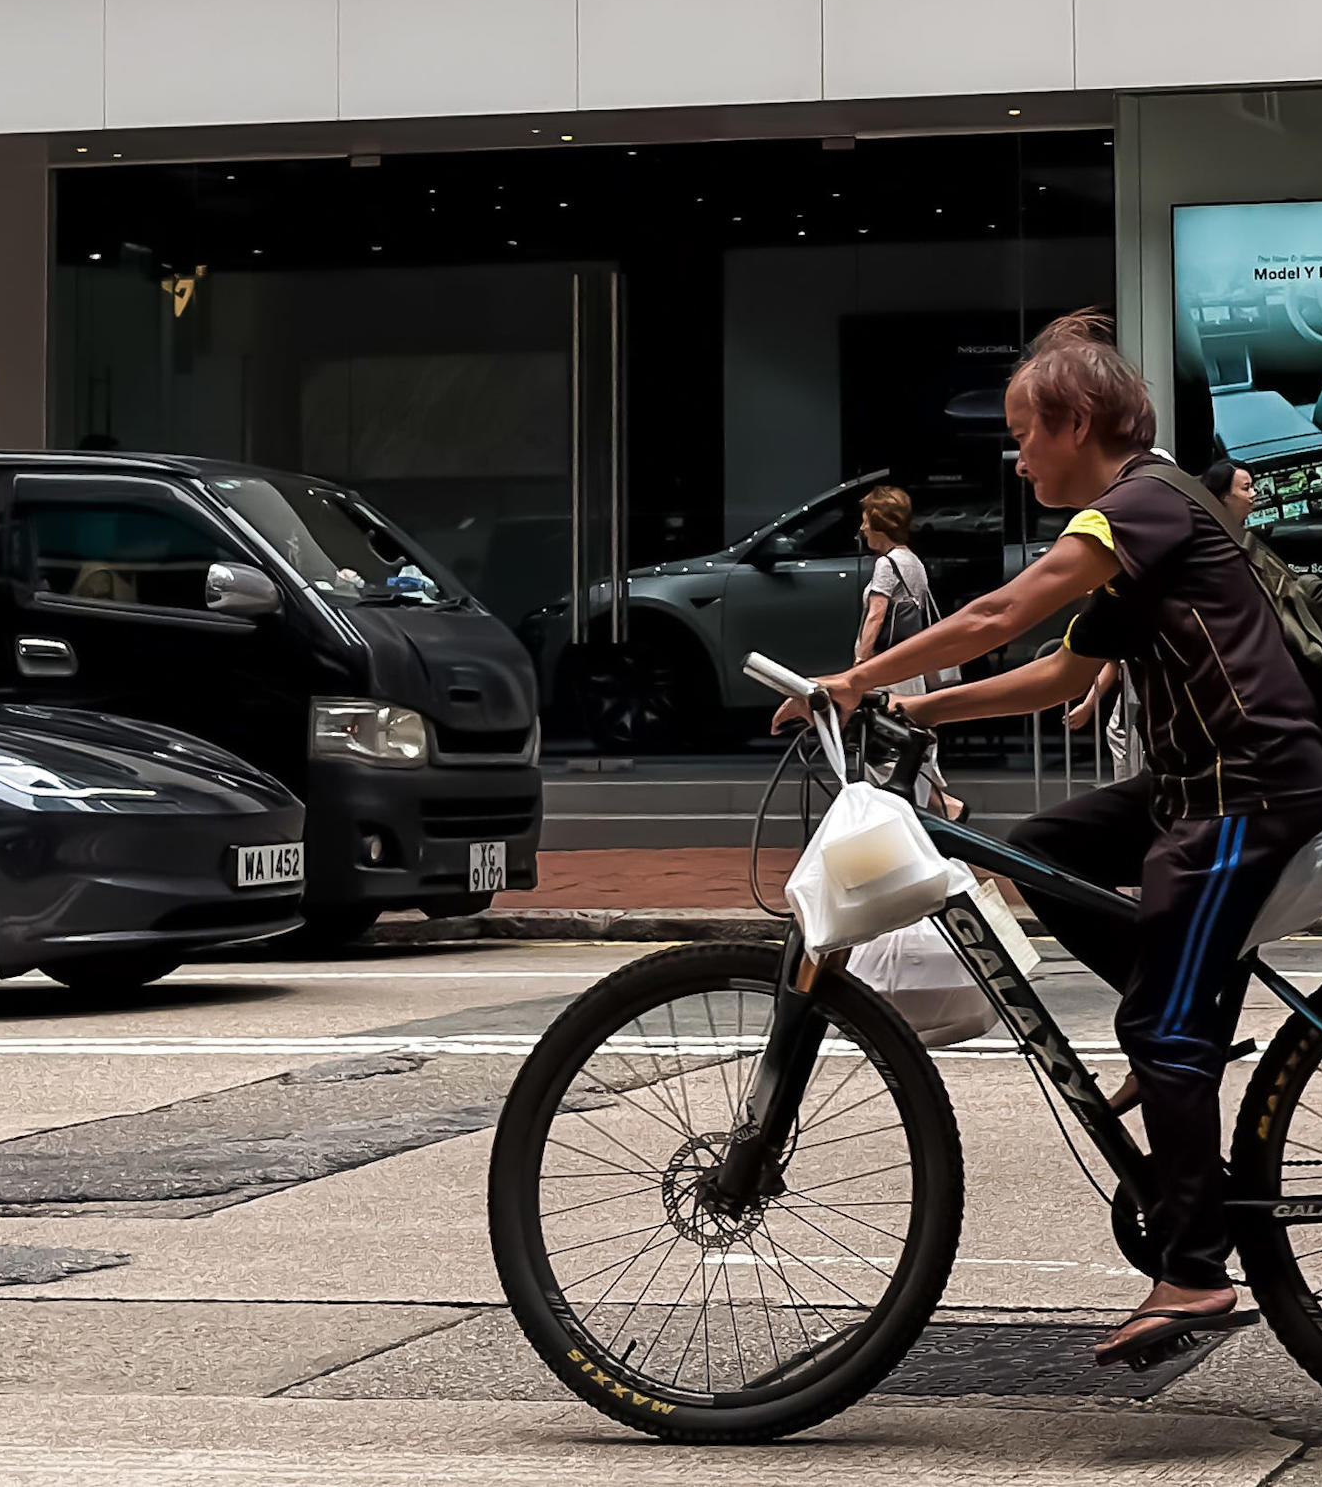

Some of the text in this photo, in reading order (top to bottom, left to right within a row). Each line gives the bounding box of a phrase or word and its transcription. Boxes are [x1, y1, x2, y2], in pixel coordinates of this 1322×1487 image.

[1254, 266, 1300, 280] Model
[1304, 265, 1315, 279] Y
[244, 848, 300, 881] WA 1452
[480, 843, 496, 865] XG
[945, 907, 1099, 1102] GALAXY
[566, 1349, 677, 1415] MAXXIS
